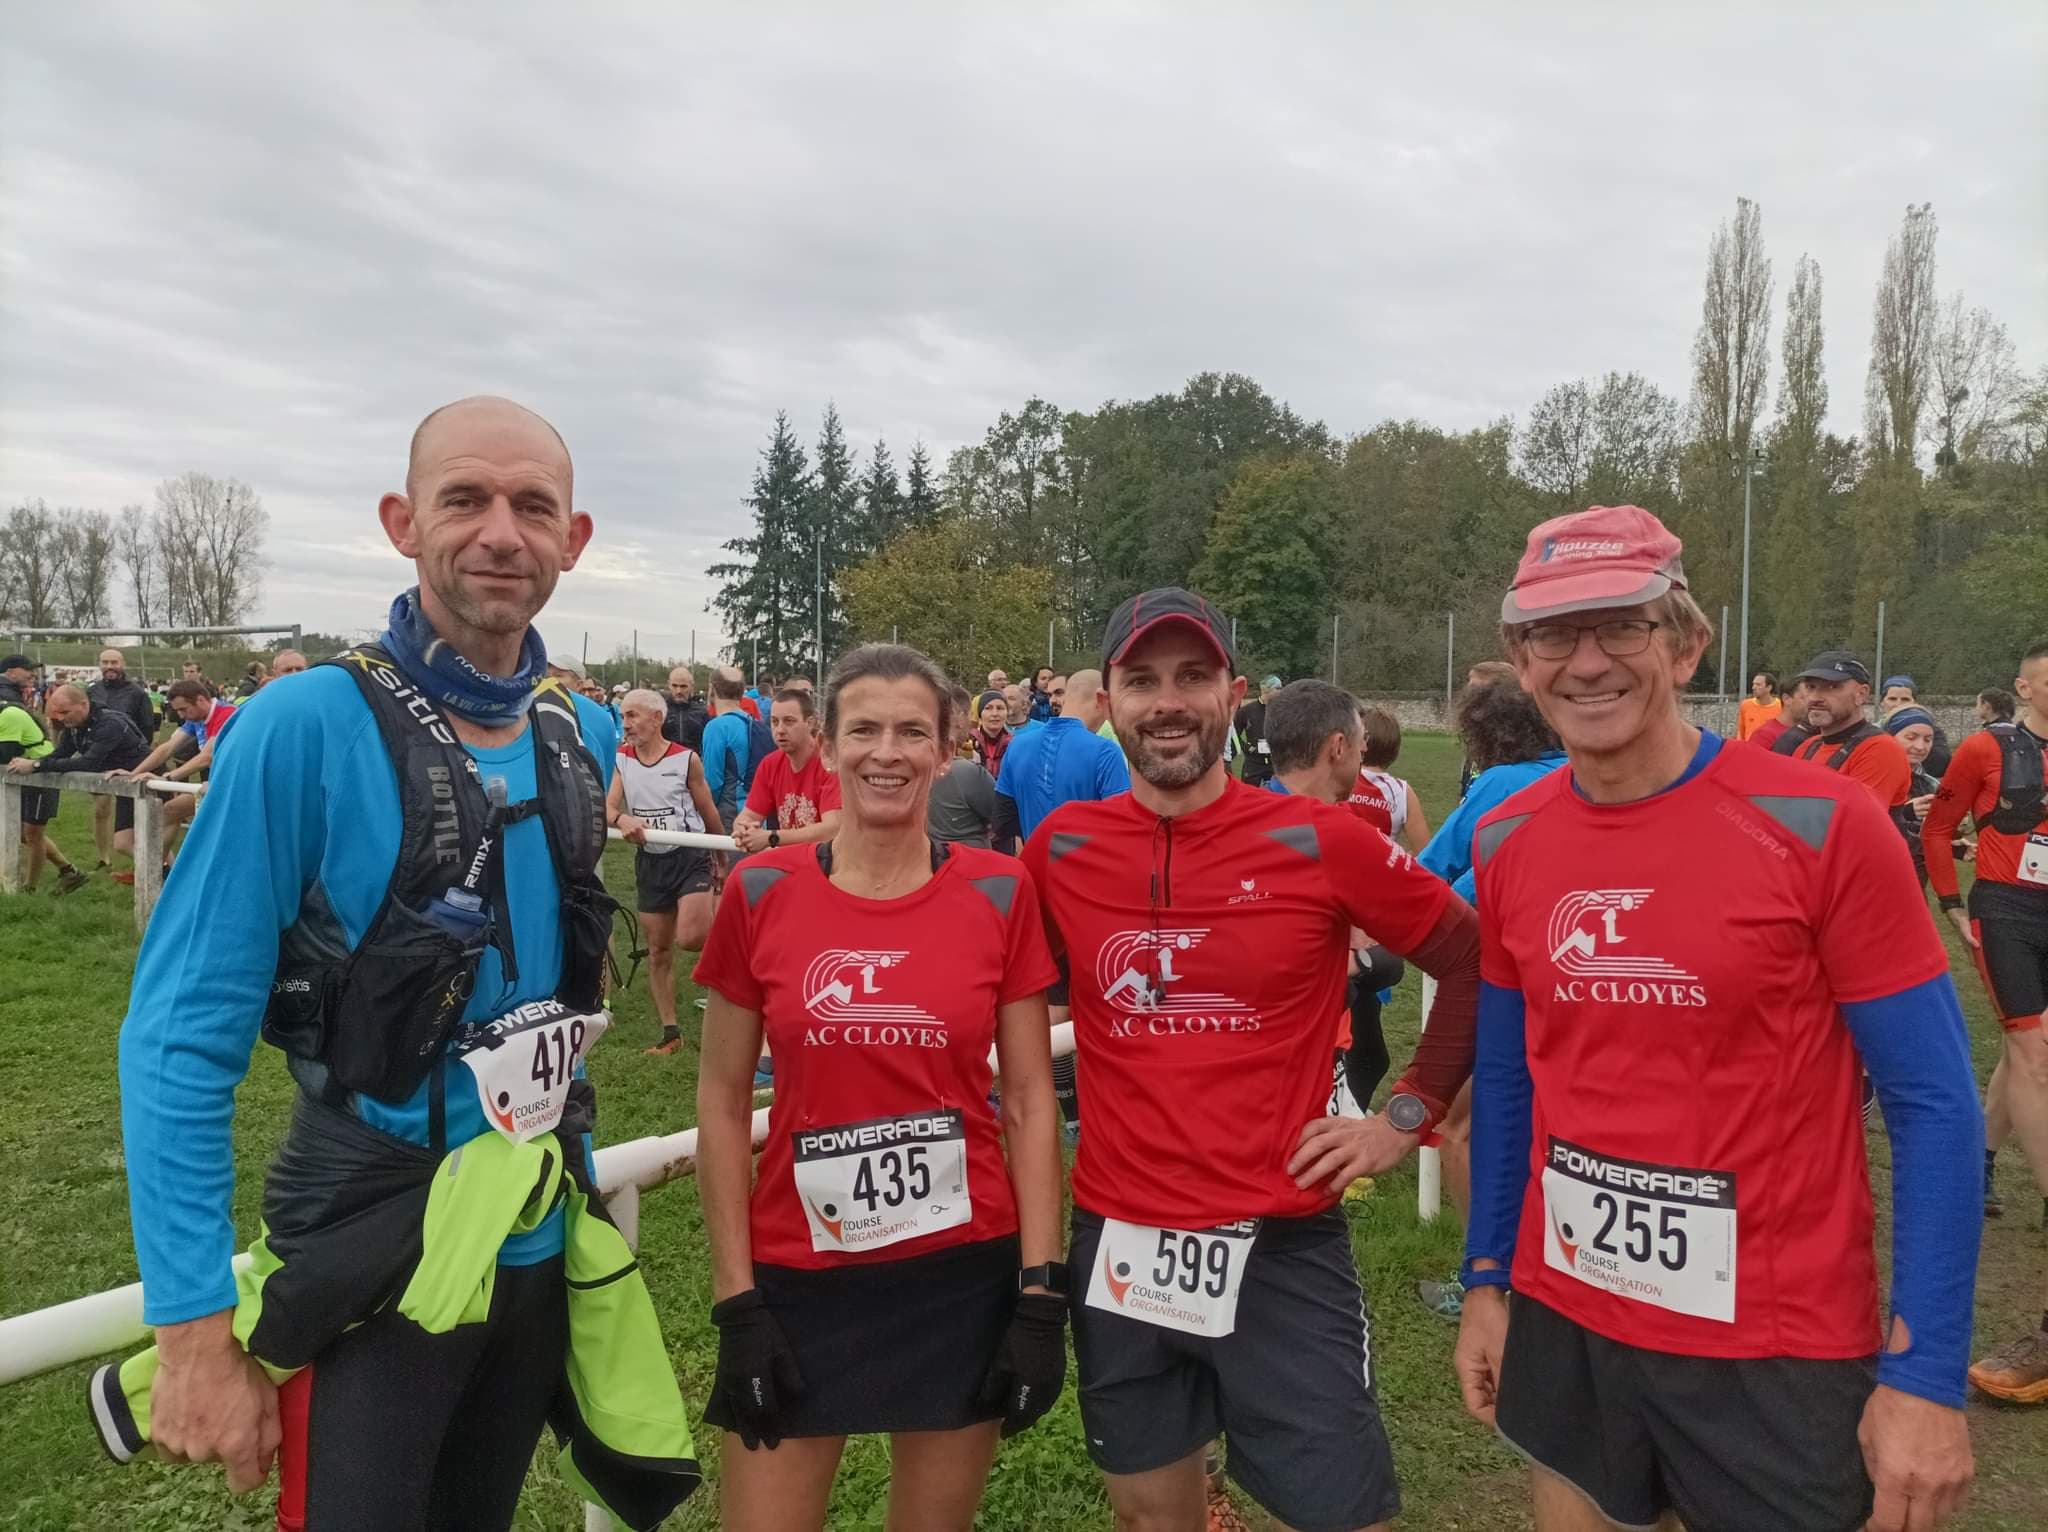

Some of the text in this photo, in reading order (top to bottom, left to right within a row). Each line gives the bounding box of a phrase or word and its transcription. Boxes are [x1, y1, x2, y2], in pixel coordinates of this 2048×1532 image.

[426, 766, 460, 865] BOTTLE
[1714, 801, 1789, 861] DIADORA
[1553, 980, 1707, 1007] AC CLOYES
[803, 1025, 949, 1049] AC CLOYES
[1109, 1014, 1262, 1038] AC CLOYES
[531, 1019, 586, 1093] 418
[514, 1097, 551, 1119] COURSE
[800, 1116, 951, 1156] POWERADE
[852, 1146, 931, 1212] 435
[1553, 1144, 1720, 1201] POWERADE
[843, 1215, 882, 1232] COURSE
[844, 1218, 918, 1245] ORGANISATION
[1592, 1191, 1688, 1272] 255
[1152, 1229, 1231, 1299] 599
[1578, 1247, 1621, 1274] COURSE
[1131, 1283, 1174, 1305] COURSE
[1579, 1261, 1664, 1298] ORGANISATION
[1129, 1298, 1207, 1326] ORGANISATION
